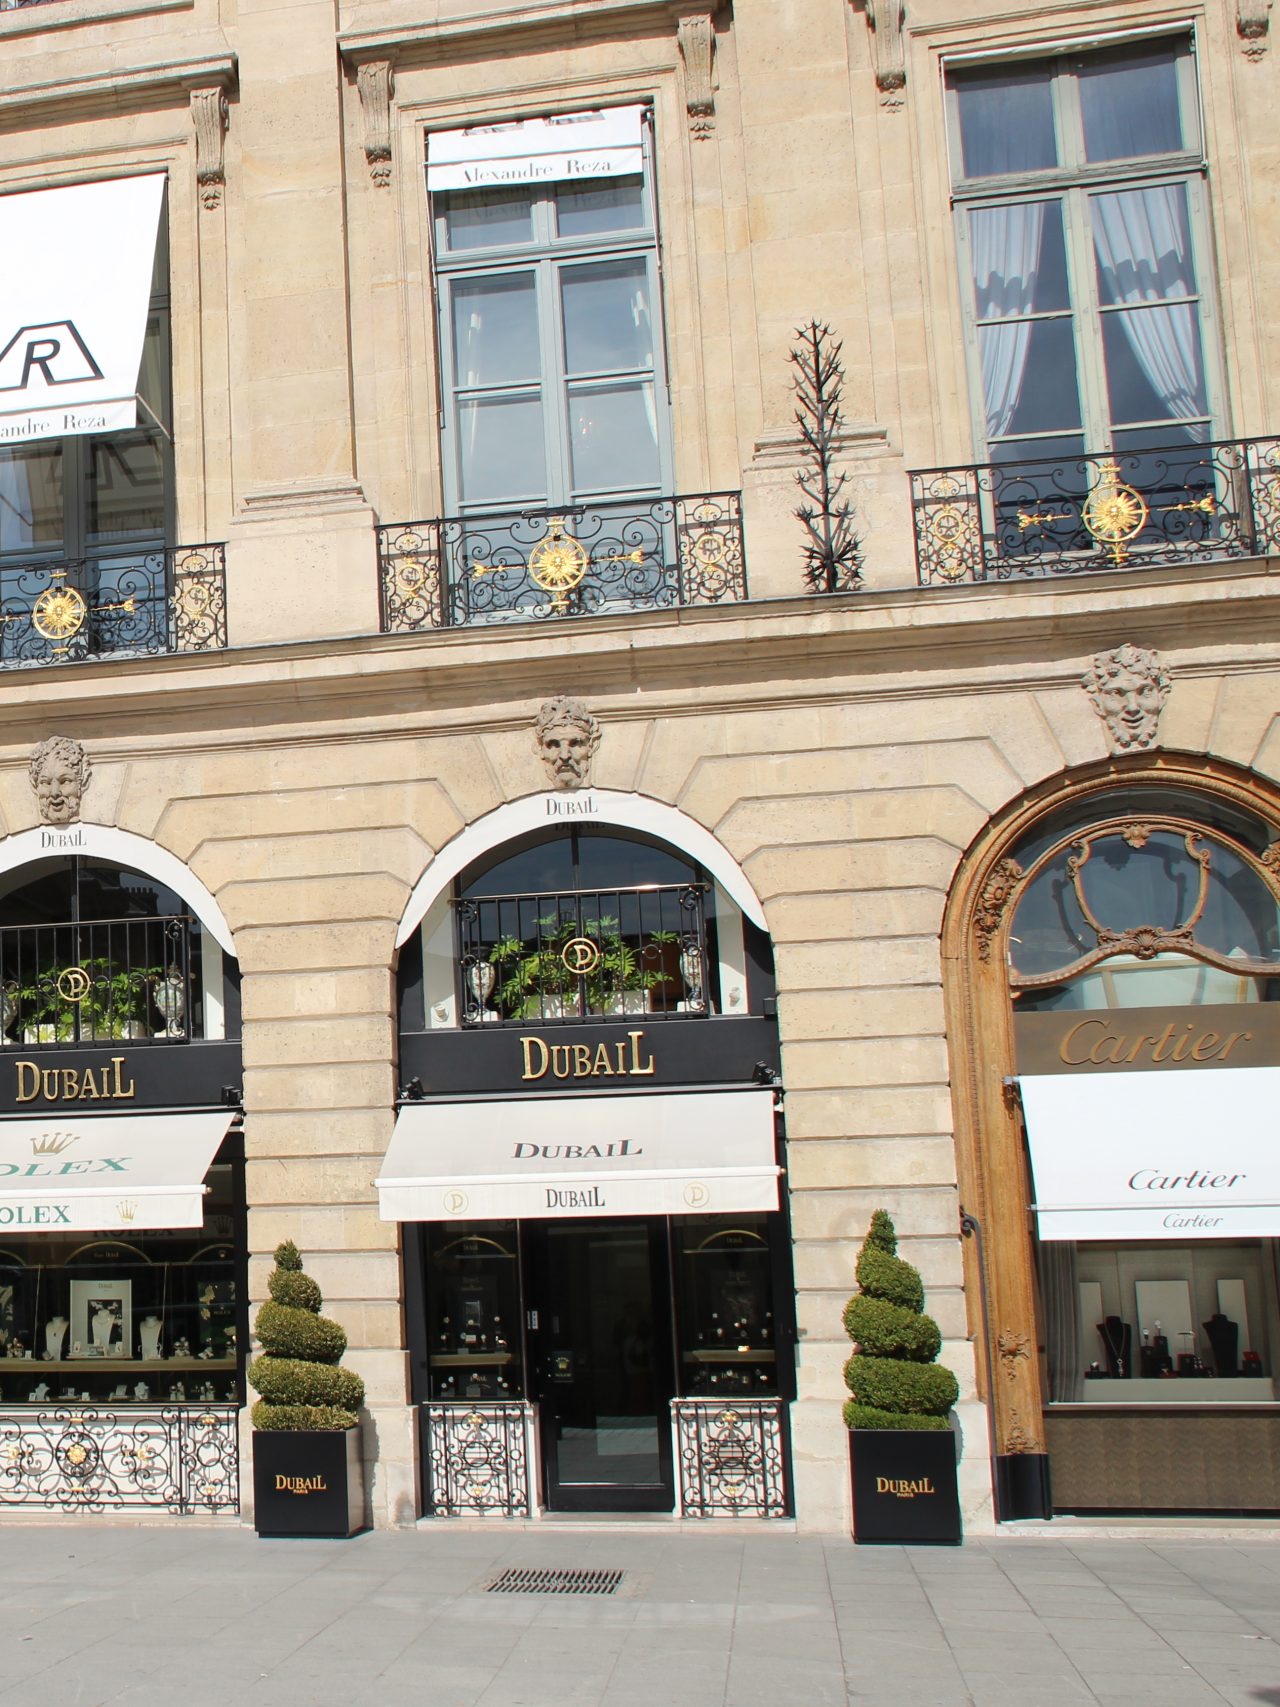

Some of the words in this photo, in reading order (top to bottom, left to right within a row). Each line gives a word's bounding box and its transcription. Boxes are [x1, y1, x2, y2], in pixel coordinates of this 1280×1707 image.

[462, 162, 553, 183] Alexandre
[566, 159, 612, 174] Reza
[63, 414, 107, 430] Reza
[546, 796, 598, 816] DUBAIL
[41, 830, 87, 849] DUBAIL
[1059, 1018, 1254, 1066] Cartier
[520, 1031, 656, 1081] DUBAIL
[15, 1057, 136, 1103] DUBAIL
[510, 1138, 643, 1159] DUBAIL
[1128, 1168, 1247, 1191] Cartier
[545, 1185, 606, 1208] DUBAIL
[1162, 1213, 1223, 1229] Cartier
[275, 1474, 327, 1490] DUBAIL
[876, 1477, 935, 1493] DUBAIL
